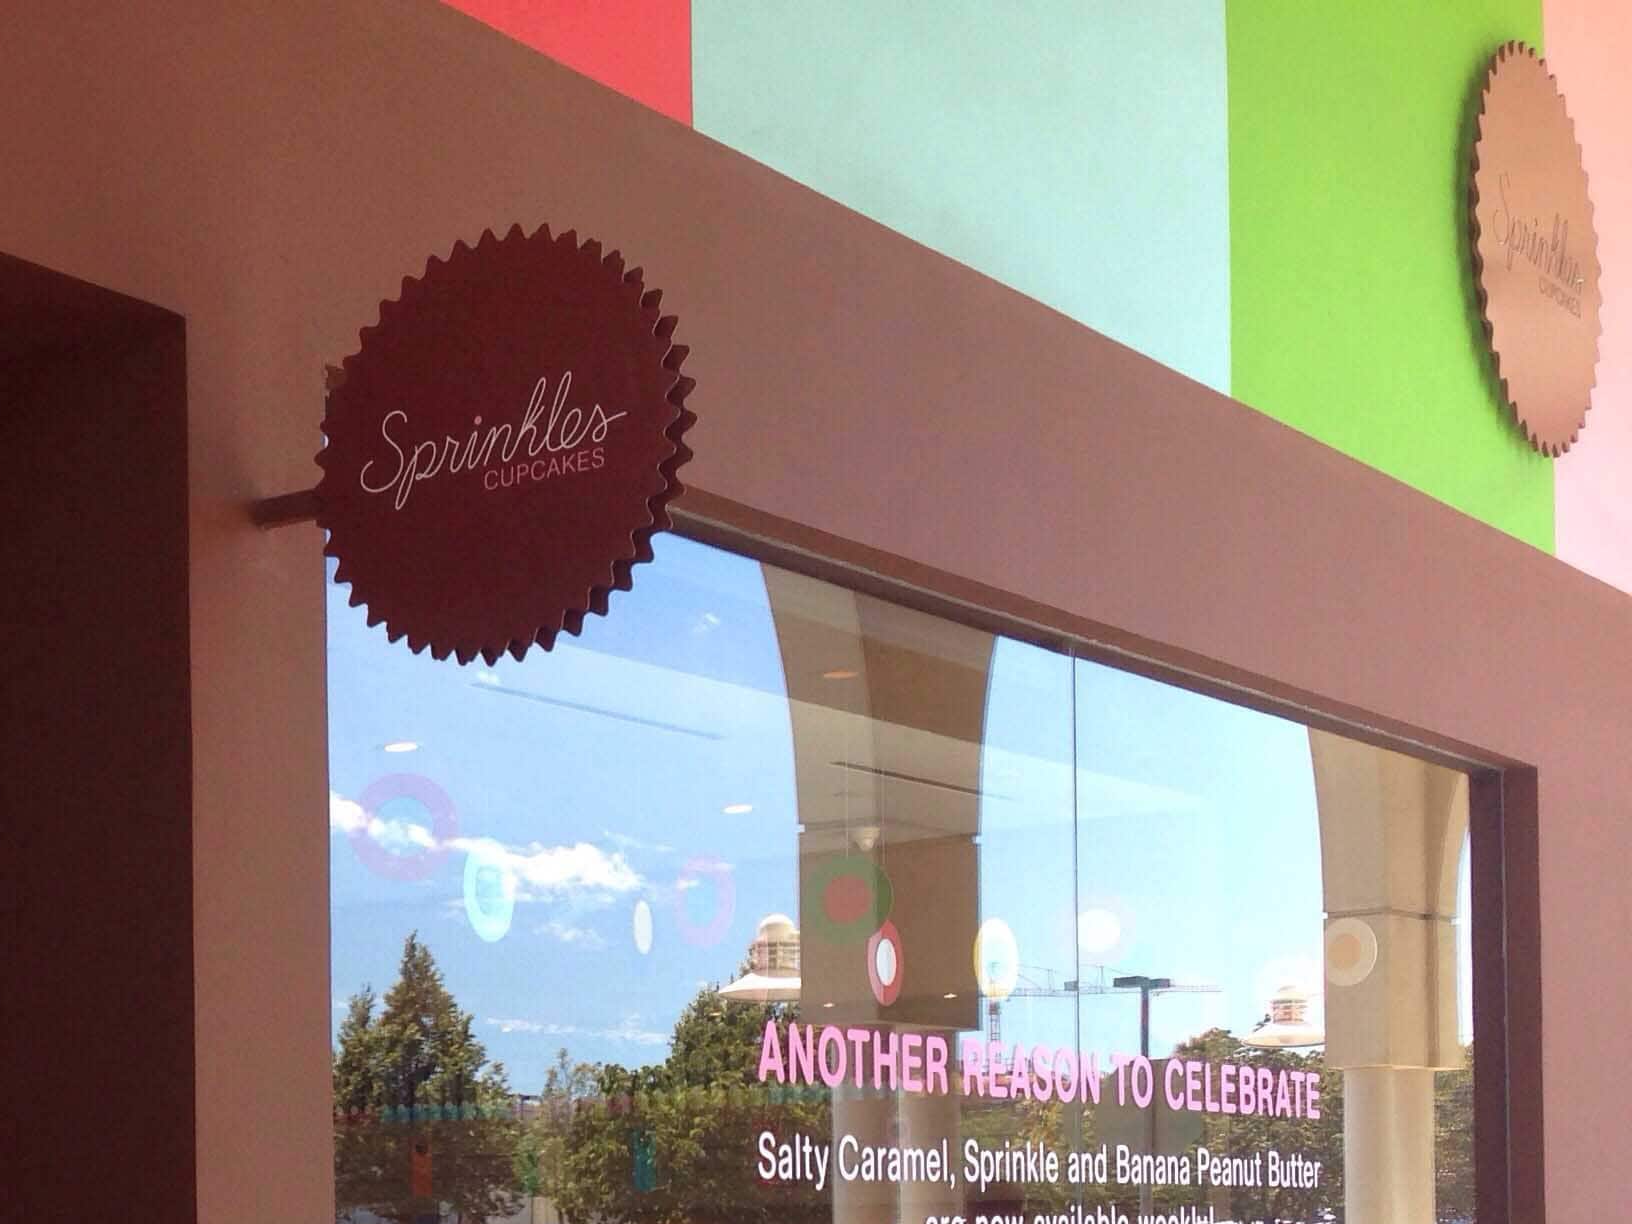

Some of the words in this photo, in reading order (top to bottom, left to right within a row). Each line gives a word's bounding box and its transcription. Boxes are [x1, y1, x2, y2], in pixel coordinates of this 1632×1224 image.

[360, 370, 628, 510] Sprinkles
[483, 447, 606, 490] CUPCAKES
[758, 1019, 948, 1095] ANOTHER
[960, 1036, 1101, 1105] REASON
[1110, 1052, 1153, 1109] TO
[1165, 1058, 1321, 1119] CELEBRATE
[757, 1130, 829, 1191] Salty
[838, 1134, 956, 1190] Caramel,
[963, 1138, 1059, 1193] Sprinkle
[1067, 1143, 1107, 1185] and
[1117, 1144, 1191, 1186] Banana
[1197, 1147, 1263, 1187] Peanut
[1268, 1150, 1321, 1188] Butter
